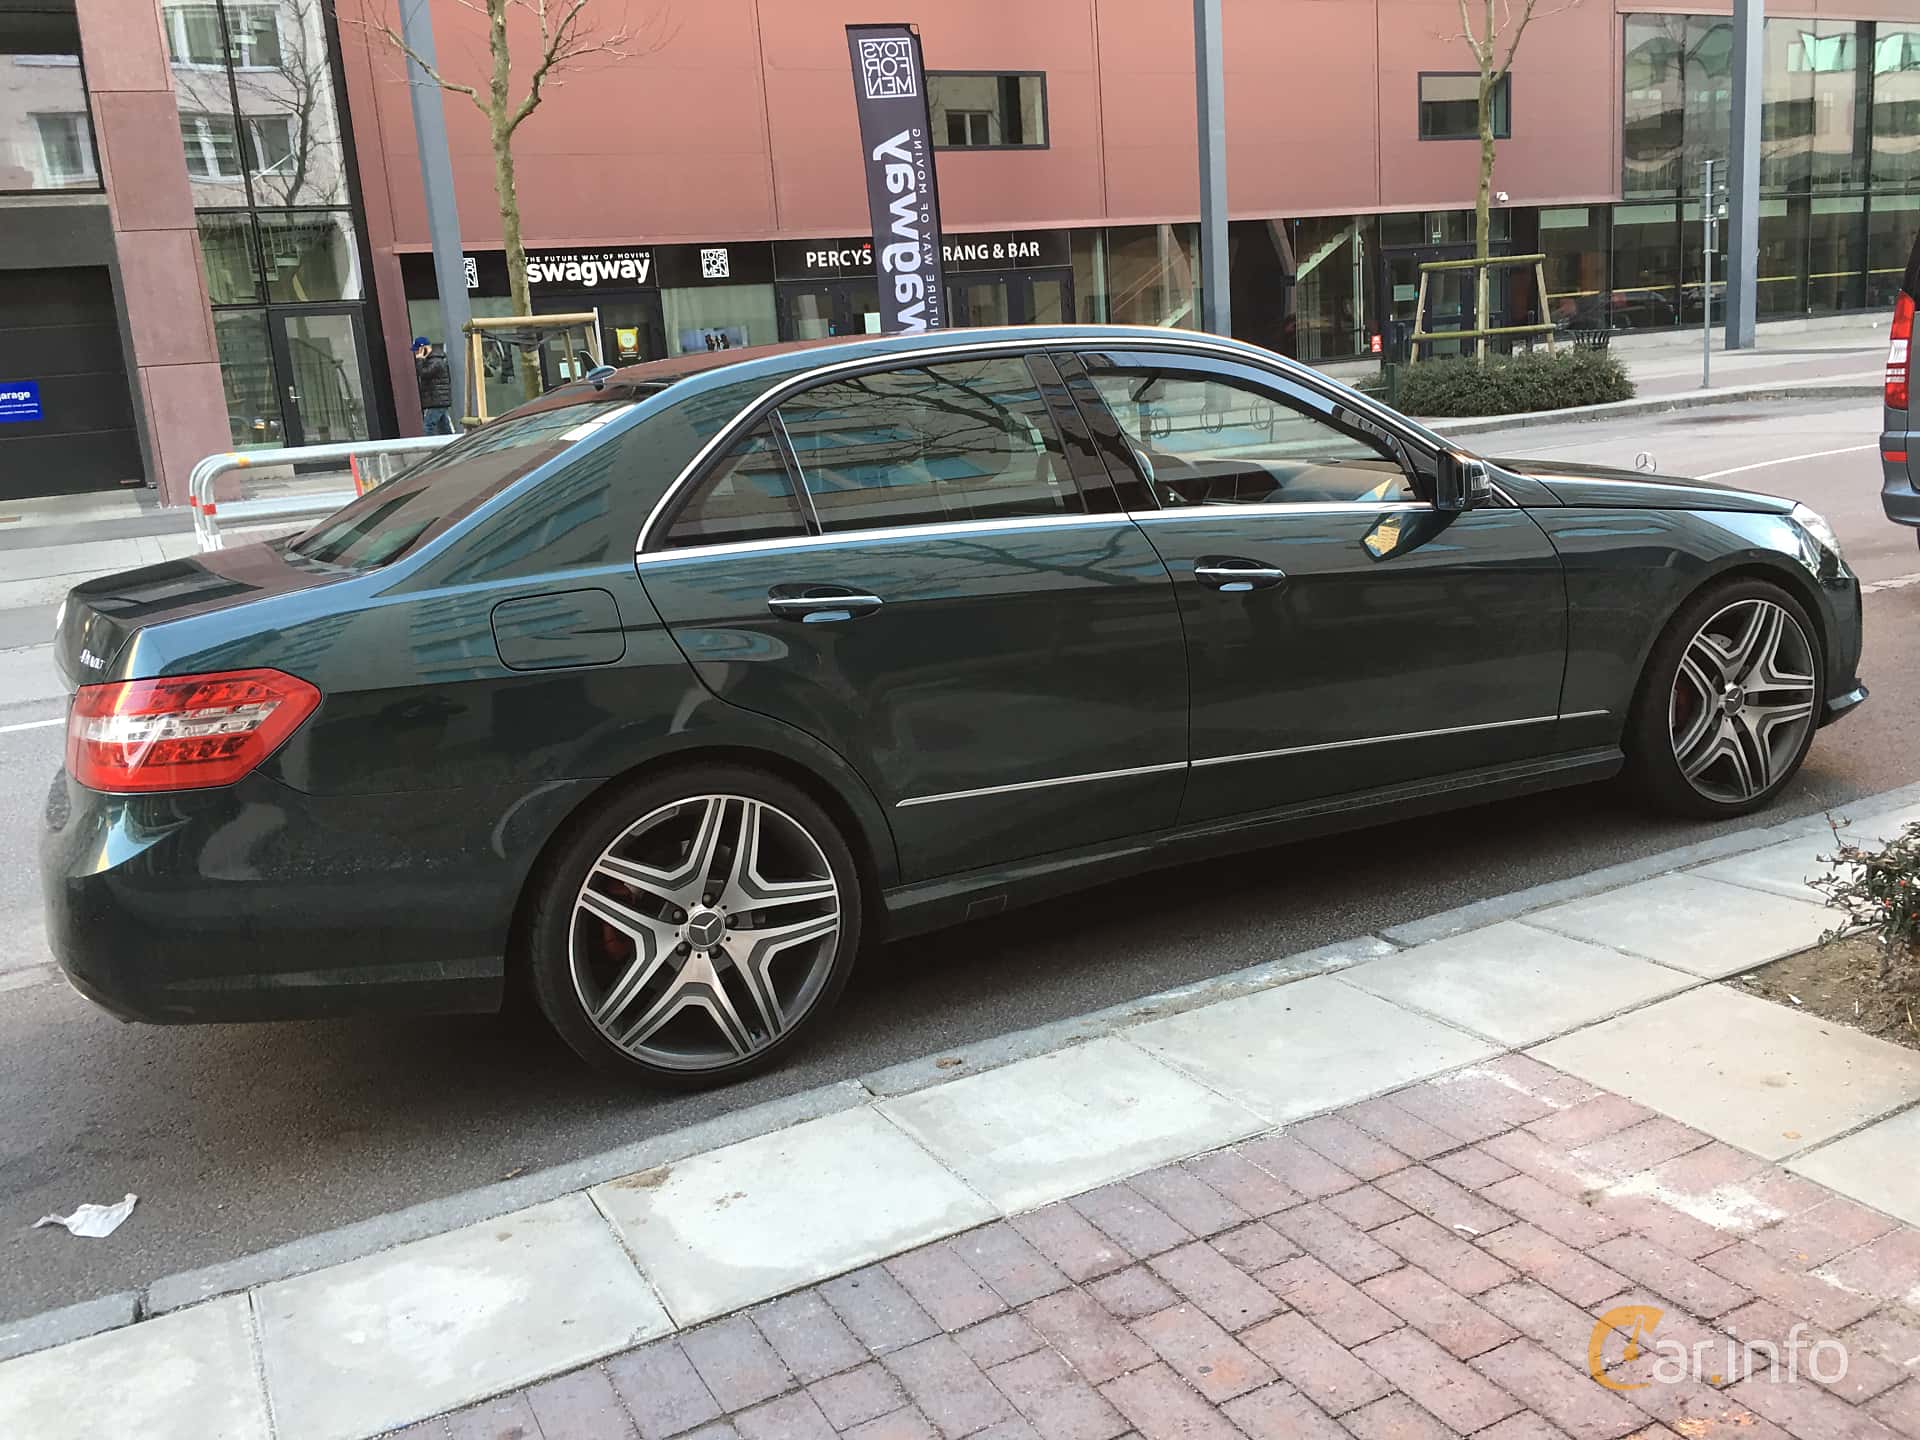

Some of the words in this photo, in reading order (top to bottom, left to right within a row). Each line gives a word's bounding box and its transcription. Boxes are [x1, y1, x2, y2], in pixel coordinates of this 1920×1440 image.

[544, 254, 578, 262] FUTURE
[617, 251, 650, 260] MOVING
[942, 244, 989, 262] RANG
[992, 243, 1005, 259] &
[1007, 241, 1041, 258] BAR
[526, 258, 650, 287] swagway
[0, 391, 31, 402] arage
